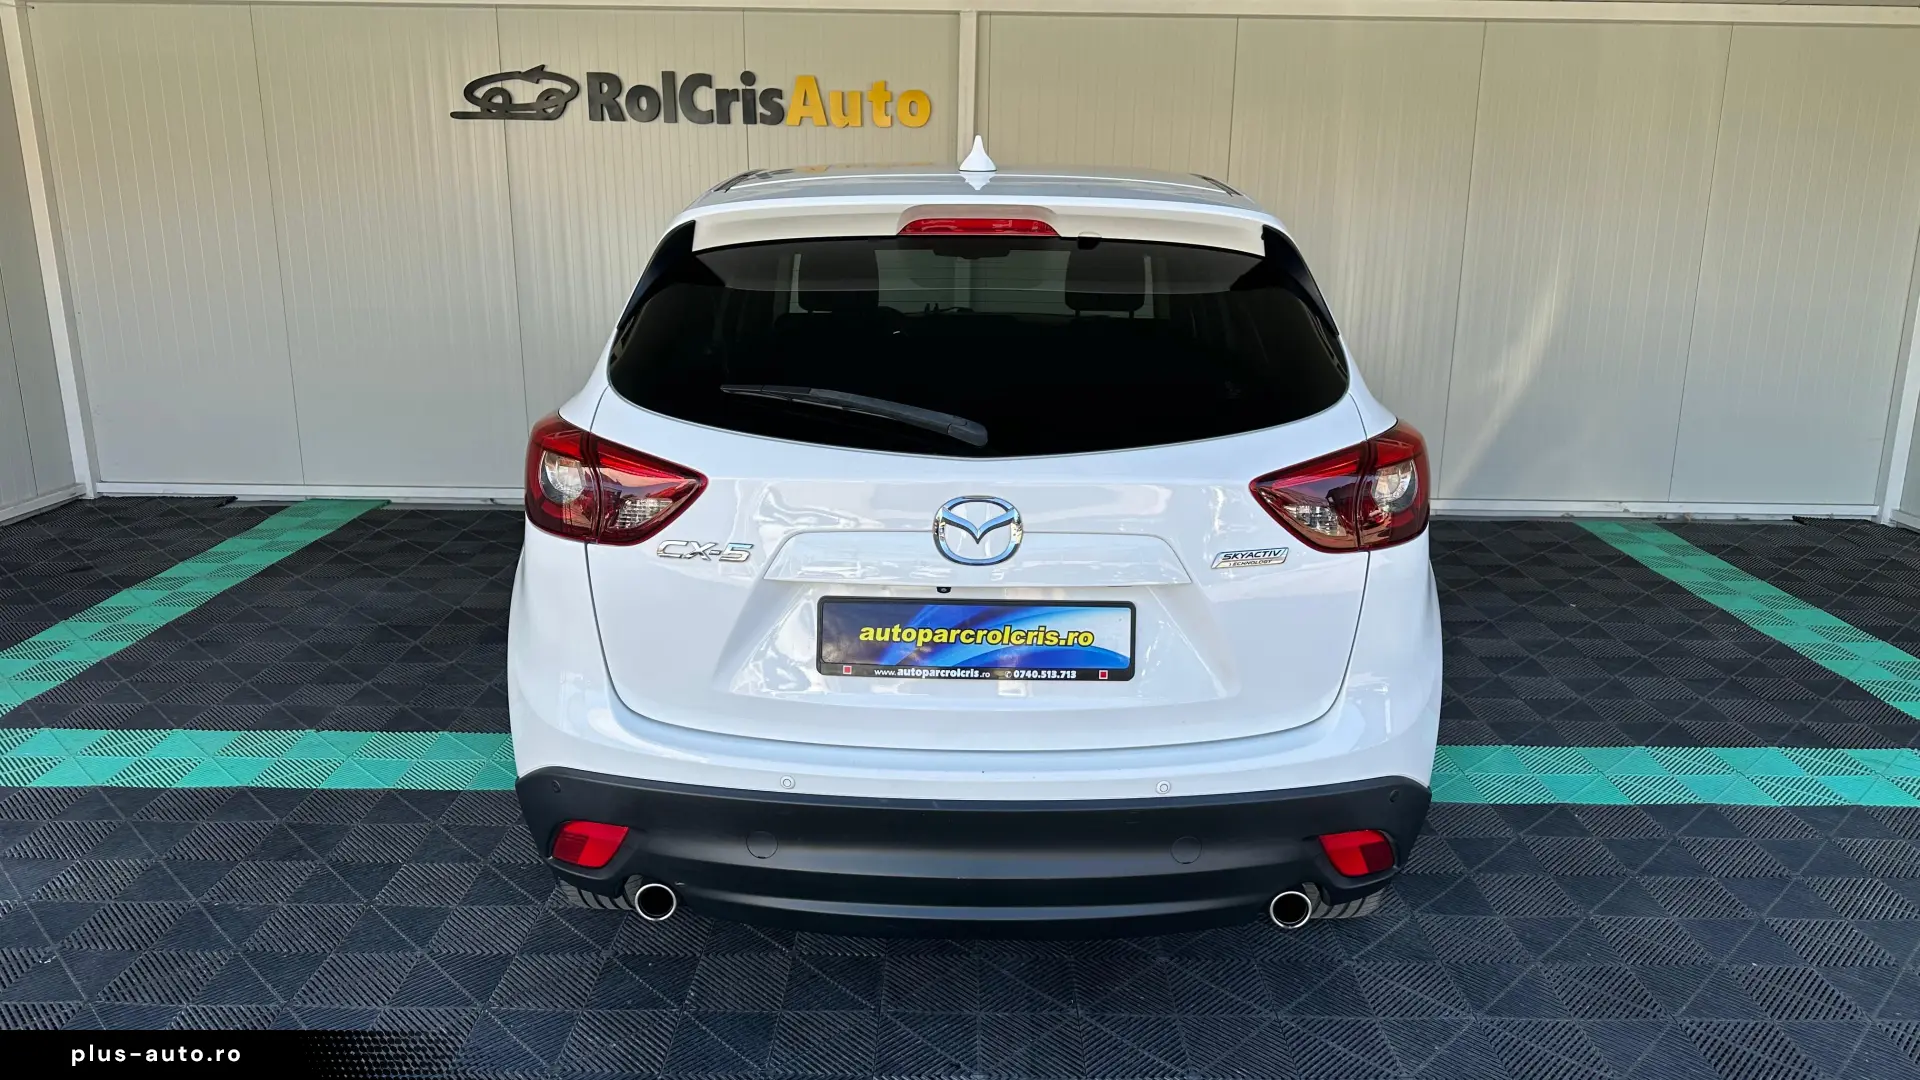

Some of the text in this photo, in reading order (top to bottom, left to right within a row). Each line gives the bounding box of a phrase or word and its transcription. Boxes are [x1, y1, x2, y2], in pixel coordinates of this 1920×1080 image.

[586, 70, 932, 128] RolCrisAuto
[656, 540, 754, 562] CX-5
[1222, 549, 1282, 560] SKYACTIV
[858, 623, 1095, 647] autoparcrolcris.ro
[1013, 669, 1077, 679] 0740.513.713
